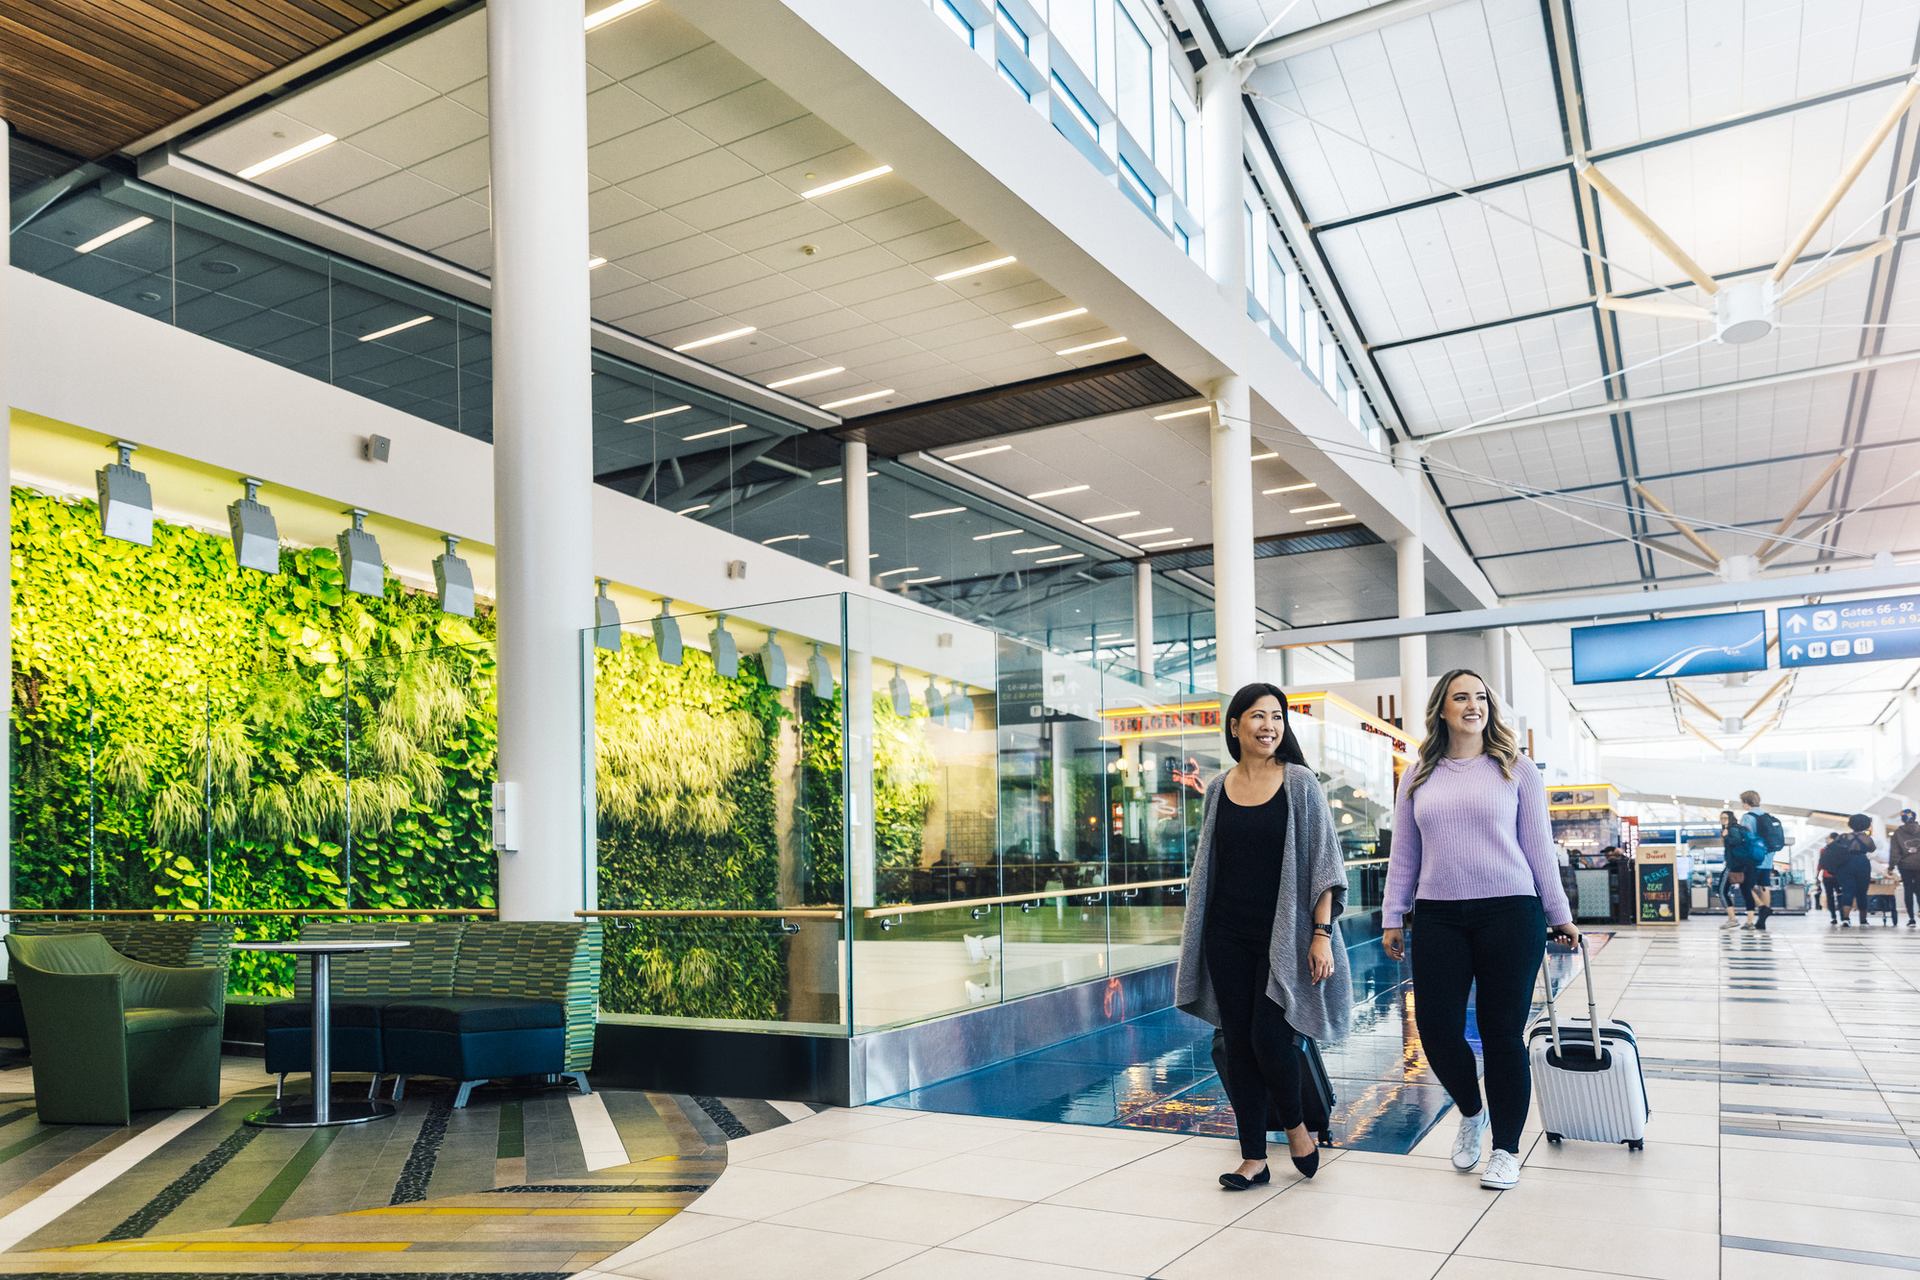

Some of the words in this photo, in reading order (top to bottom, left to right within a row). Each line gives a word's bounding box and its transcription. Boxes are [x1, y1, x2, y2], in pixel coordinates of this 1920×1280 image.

[1841, 608, 1873, 617] Gates
[1841, 620, 1875, 629] Portes
[1881, 617, 1894, 625] 66
[1643, 867, 1669, 883] PLEASE
[1646, 883, 1663, 891] SEAT
[1643, 891, 1671, 901] YOURSELF
